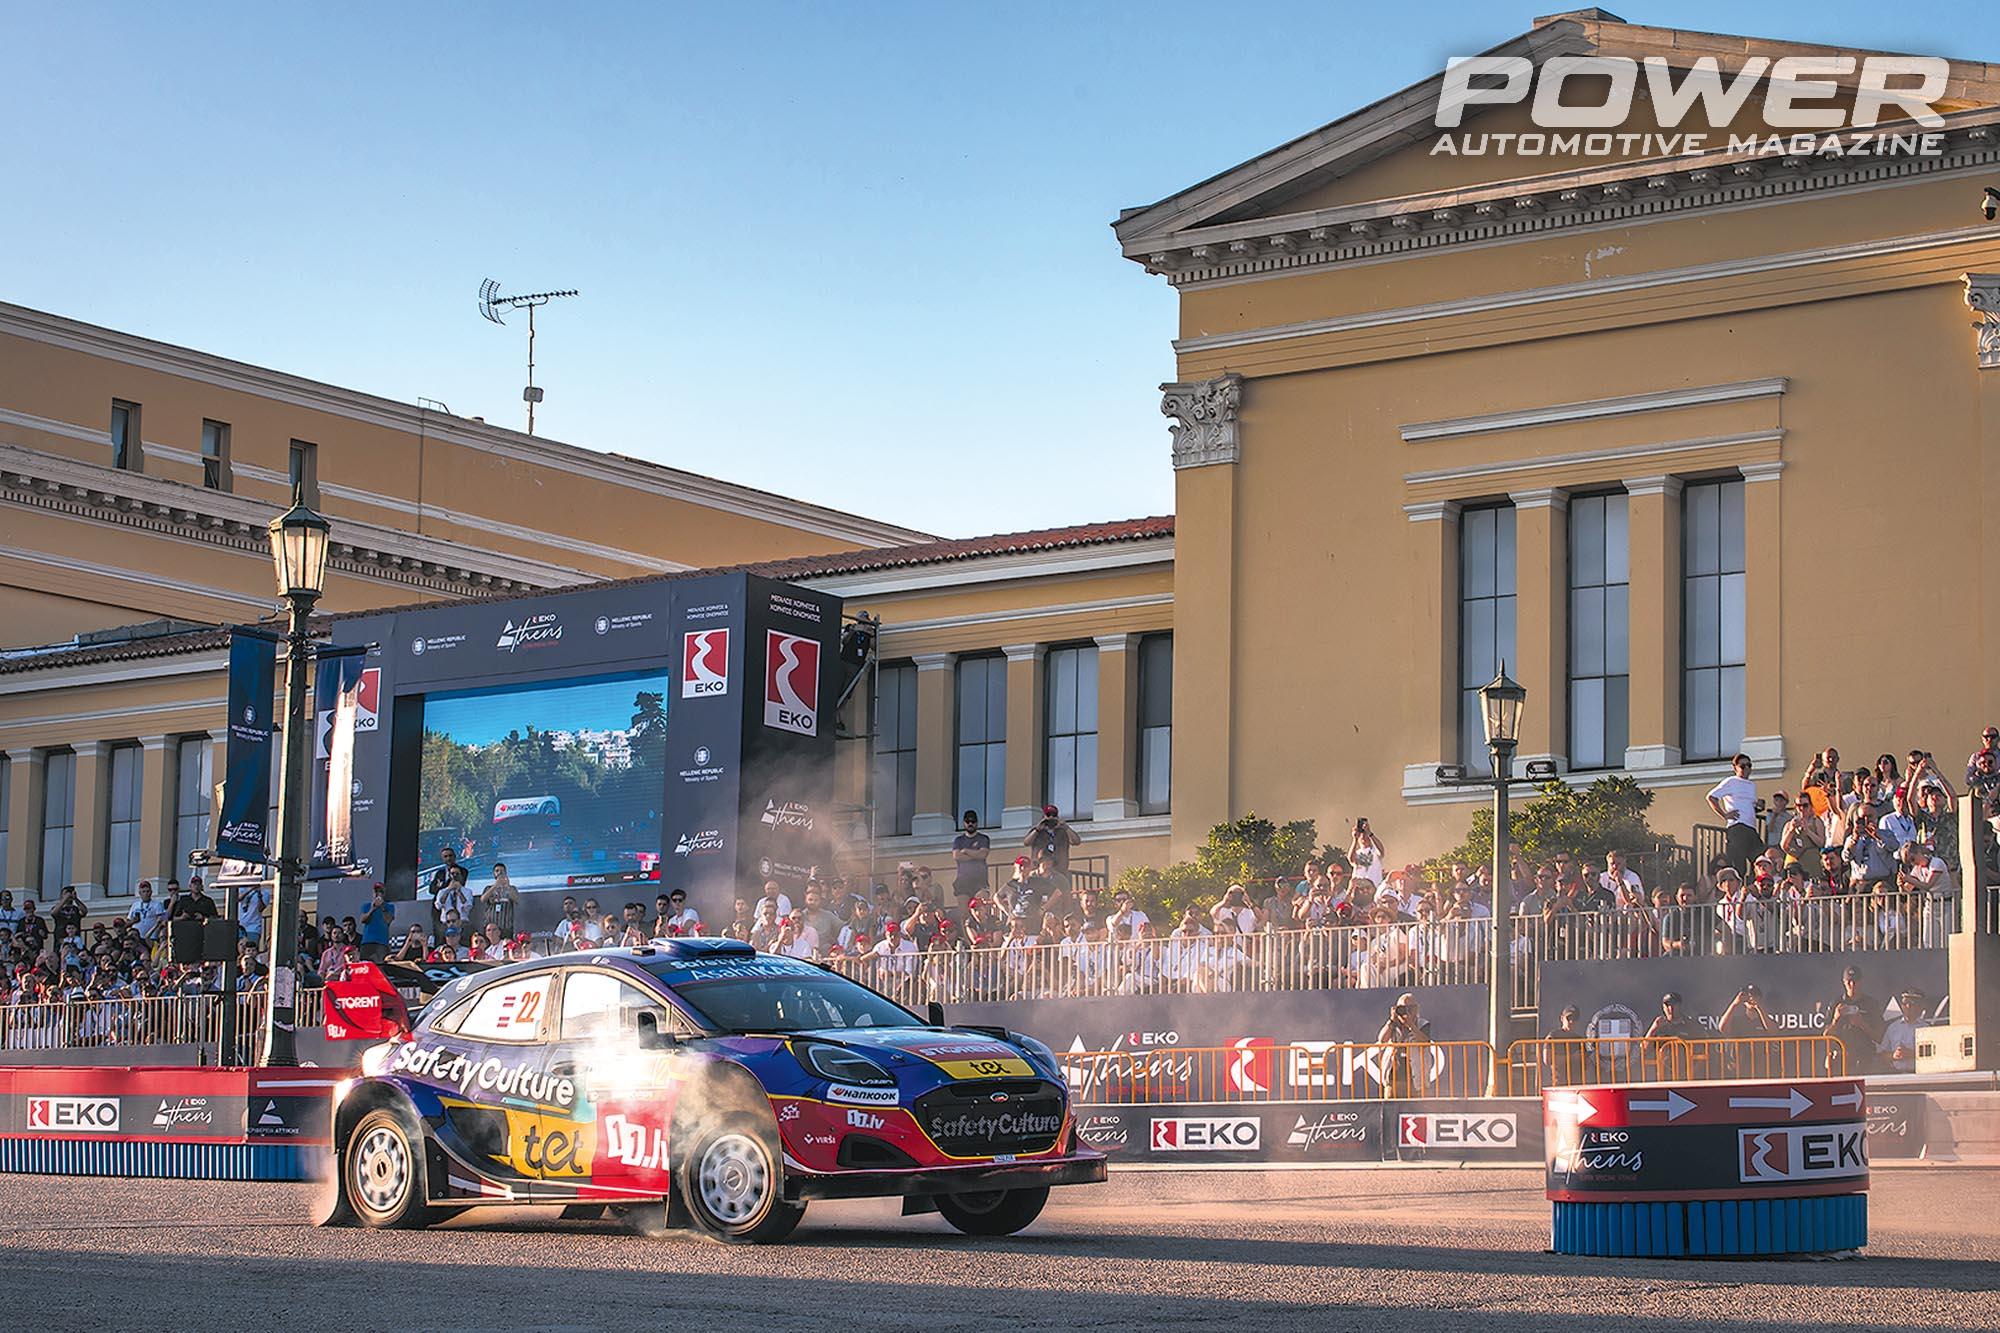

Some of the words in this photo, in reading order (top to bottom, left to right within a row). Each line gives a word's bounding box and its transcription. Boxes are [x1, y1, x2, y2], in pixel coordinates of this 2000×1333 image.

[538, 613, 556, 622] EKO
[695, 681, 724, 693] EKO
[779, 709, 813, 729] EKO
[335, 996, 380, 1009] STORENT
[515, 991, 541, 1023] 22
[1142, 1031, 1179, 1045] EKO
[392, 1041, 576, 1106] SafetyCulture
[969, 1060, 1011, 1075] tet
[191, 1098, 207, 1106] EKO
[1874, 1105, 1898, 1114] EKO
[56, 1102, 118, 1126] EKO
[1100, 1116, 1120, 1124] EKO
[1337, 1113, 1358, 1121] EKO
[930, 1112, 1060, 1142] SafetyCulture
[1076, 1118, 1128, 1143] thens
[1184, 1122, 1258, 1146] EKO
[1436, 1118, 1516, 1143] EKO
[1600, 1131, 1629, 1143] EKO
[524, 1124, 584, 1174] tet
